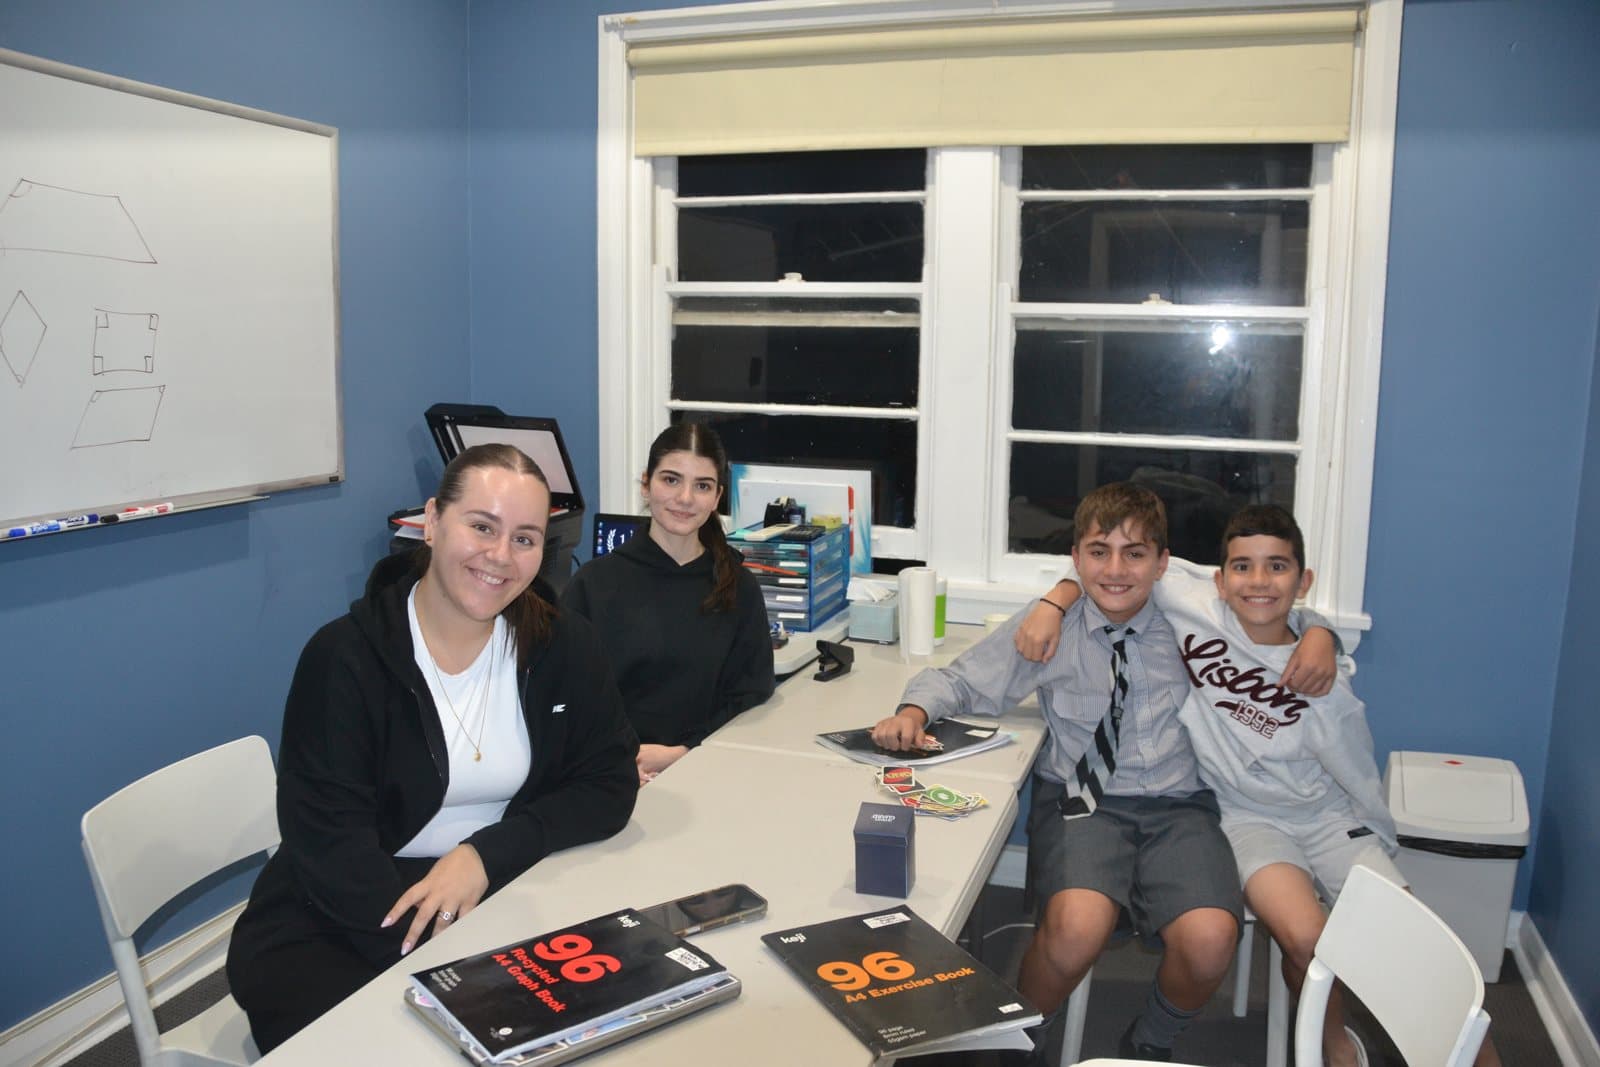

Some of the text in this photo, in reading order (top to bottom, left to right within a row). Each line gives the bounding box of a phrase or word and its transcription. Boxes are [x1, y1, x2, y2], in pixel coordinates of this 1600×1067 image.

[1178, 634, 1310, 726] Lisbon
[1230, 700, 1280, 739] 1992
[617, 914, 641, 928] keji
[780, 932, 807, 944] keji
[510, 947, 560, 984] Recycled
[533, 934, 622, 982] 96
[817, 951, 916, 991] 96
[491, 953, 567, 1013] A4 Graph Book
[845, 967, 976, 1003] A4 Exercise Book
